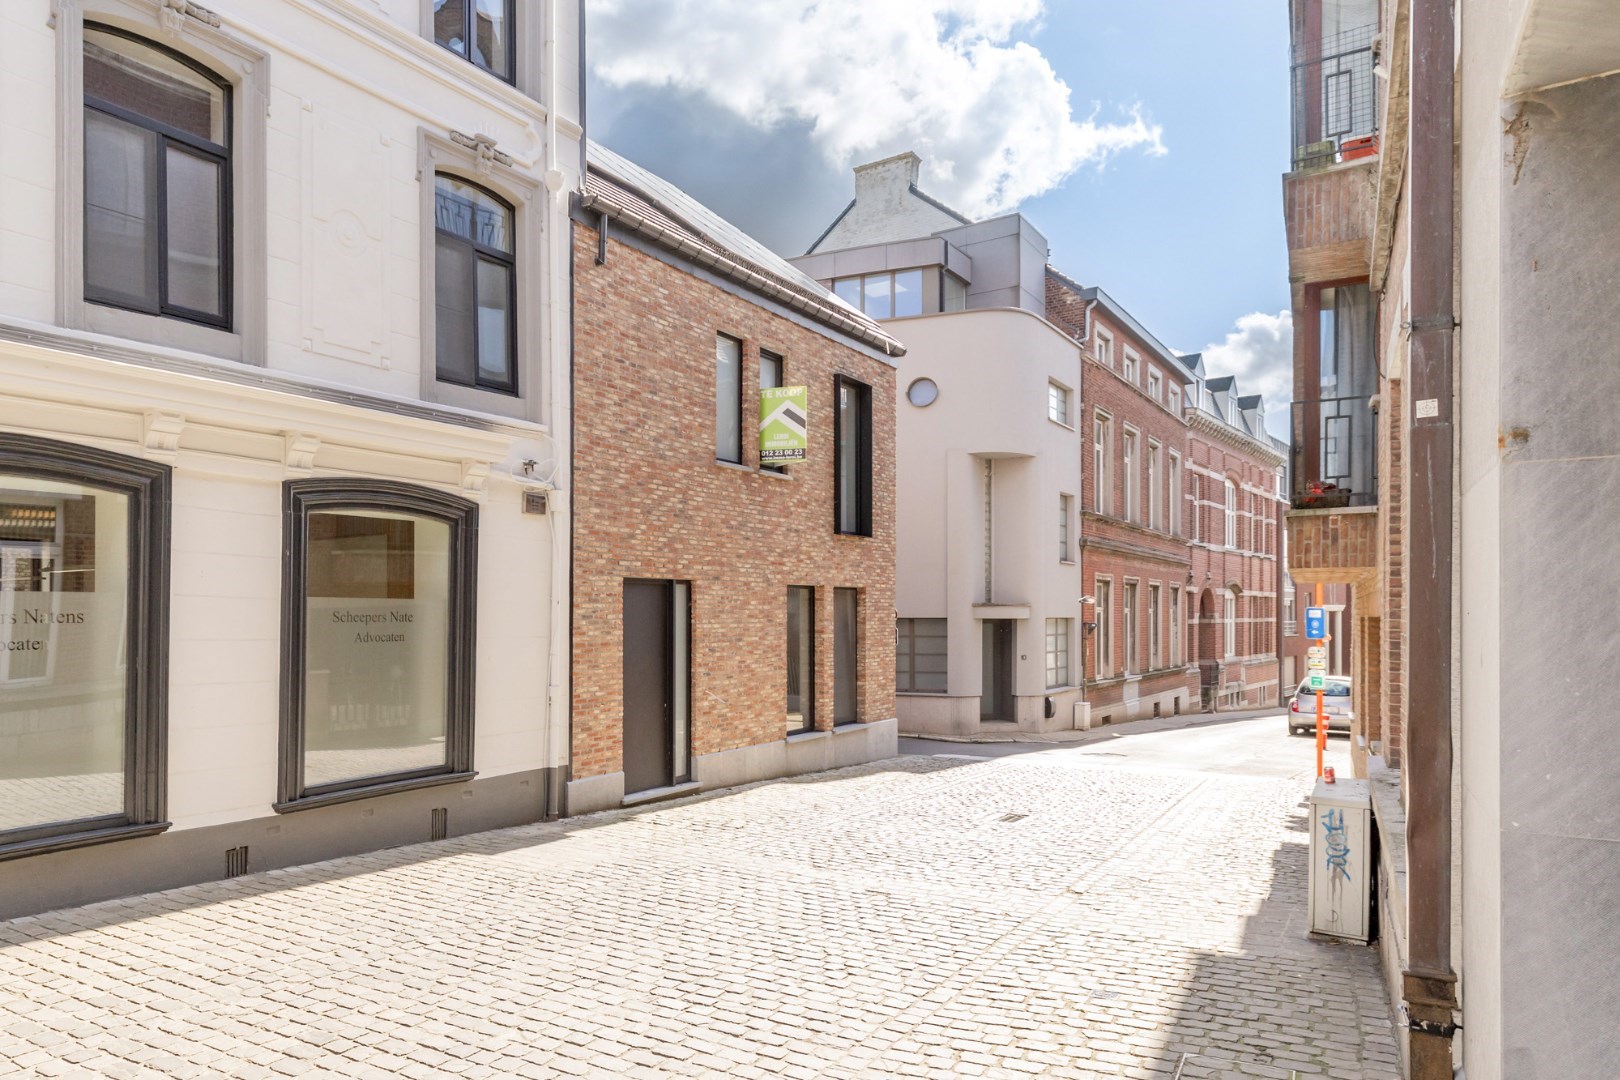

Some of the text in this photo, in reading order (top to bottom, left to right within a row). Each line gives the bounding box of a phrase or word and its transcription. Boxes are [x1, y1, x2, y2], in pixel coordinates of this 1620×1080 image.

[761, 388, 802, 399] TE KOOP
[23, 608, 85, 624] Natens
[332, 610, 387, 626] Scheepers
[354, 632, 405, 643] Advocaten
